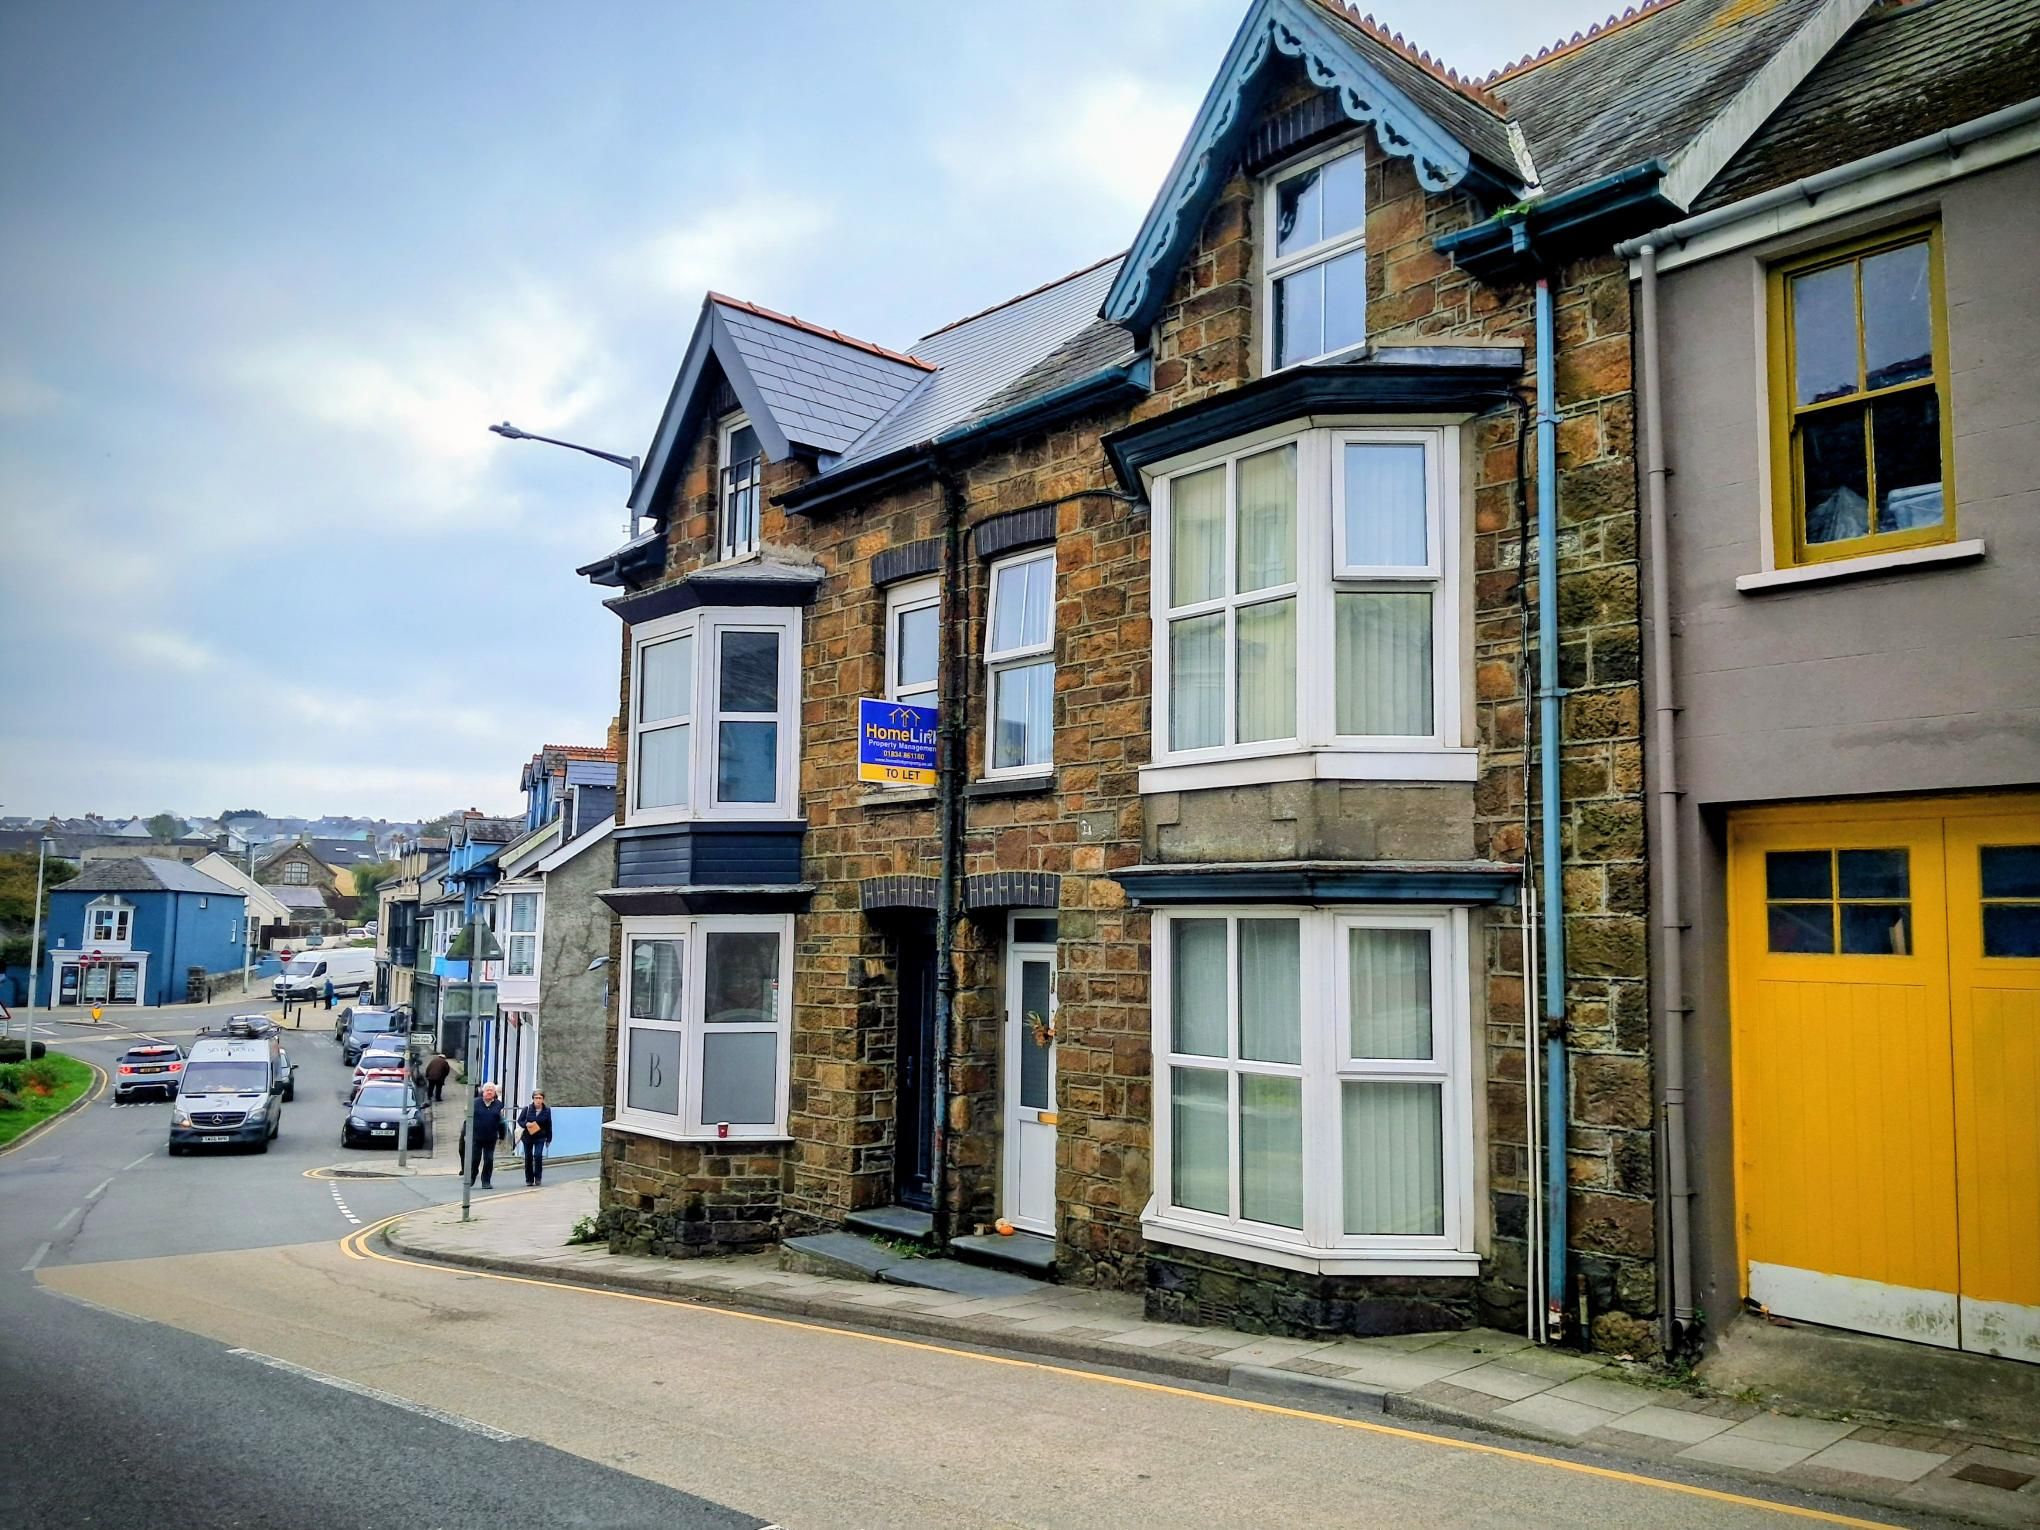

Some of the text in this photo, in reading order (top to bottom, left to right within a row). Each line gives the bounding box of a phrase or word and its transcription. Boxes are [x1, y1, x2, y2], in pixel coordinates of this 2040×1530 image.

[868, 739, 937, 752] Property Managemen
[883, 750, 902, 758] 01834
[886, 768, 921, 780] TO LET
[648, 1052, 662, 1088] B
